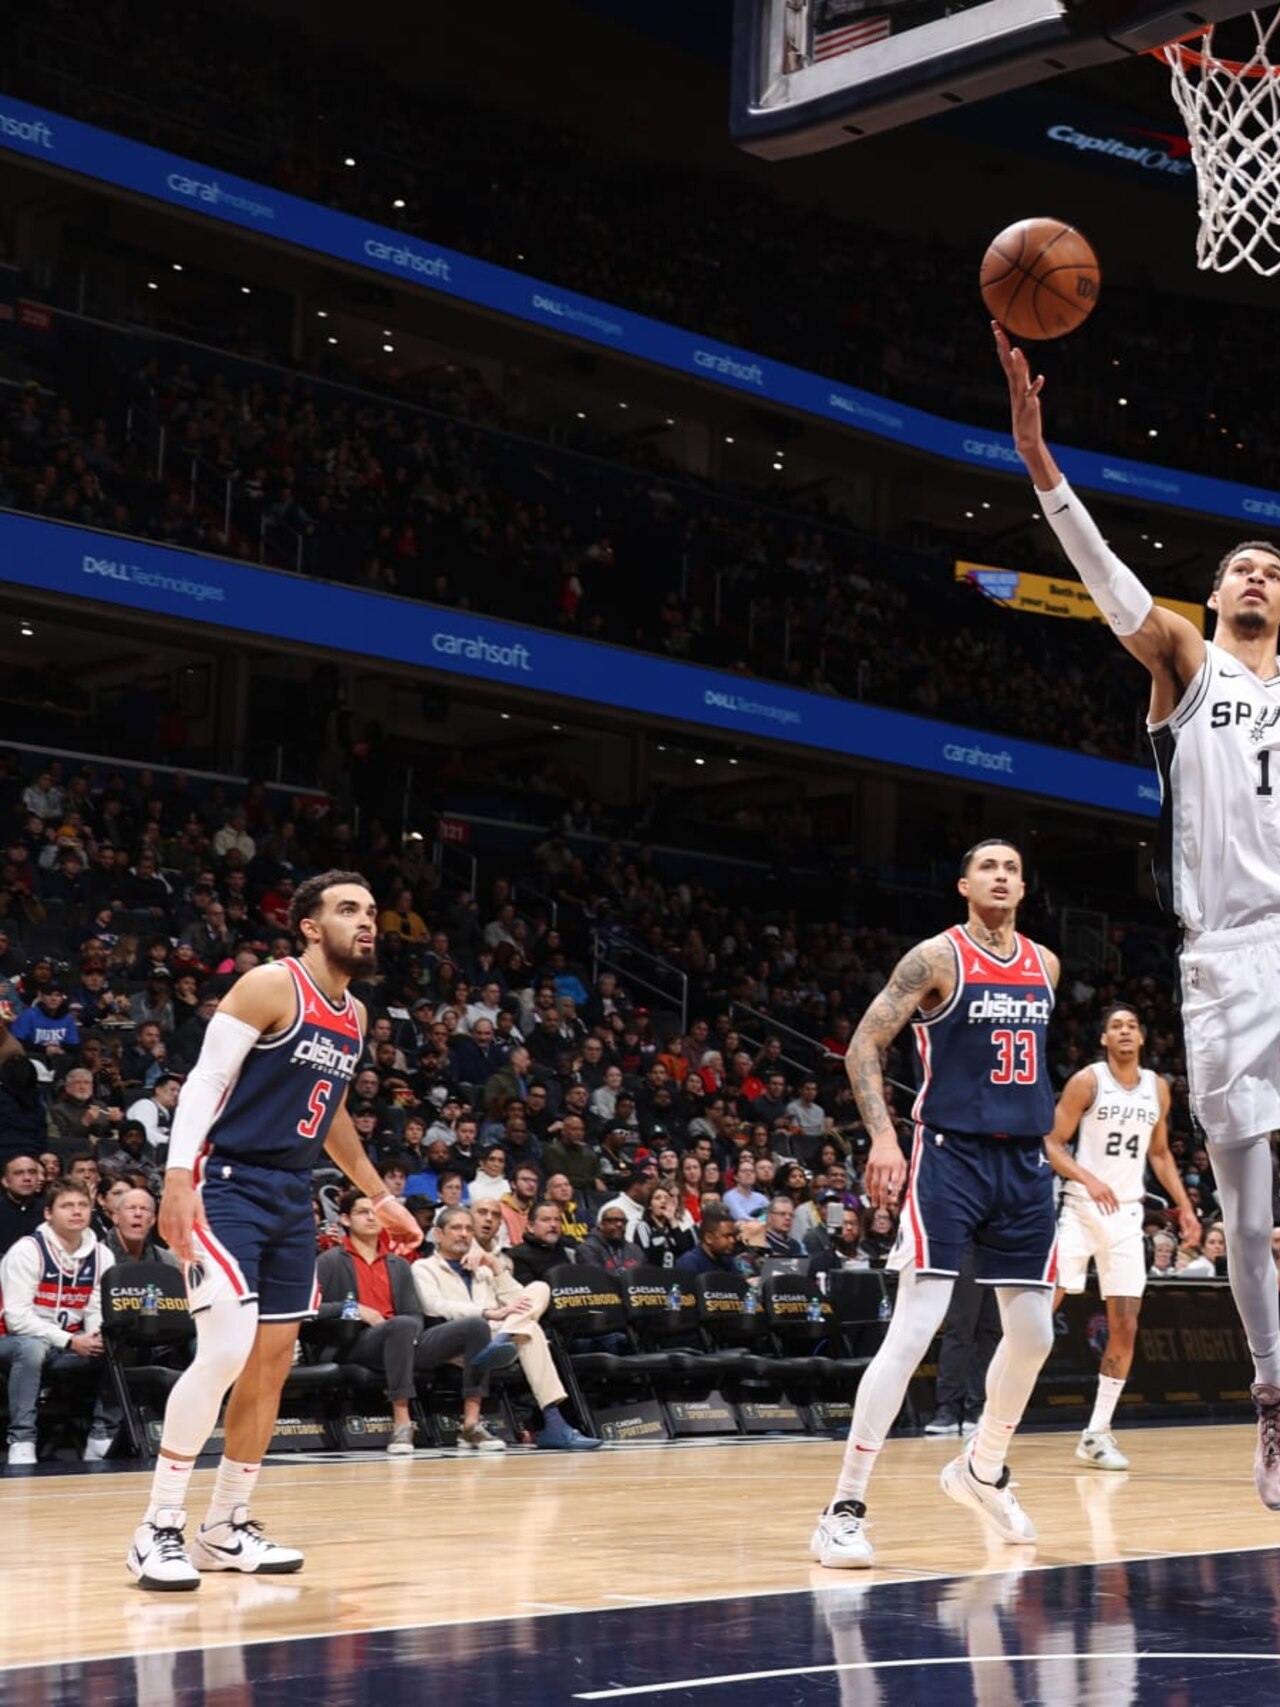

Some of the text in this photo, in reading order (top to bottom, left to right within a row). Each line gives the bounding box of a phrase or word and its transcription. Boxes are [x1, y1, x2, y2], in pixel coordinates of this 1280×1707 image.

[364, 239, 451, 282] carahsoft
[532, 294, 564, 317] DELL
[693, 349, 763, 387] carahsoft
[82, 555, 226, 602] DELL Technologies
[432, 631, 534, 672] carahsoft
[705, 690, 739, 712] DELL
[943, 742, 1016, 775] carahsoft
[1256, 749, 1273, 796] 1
[968, 990, 1049, 1019] district
[990, 1029, 1038, 1085] 33
[297, 1079, 333, 1138] 5
[1097, 1106, 1157, 1127] SPURS
[1105, 1132, 1139, 1158] 24
[552, 1286, 592, 1297] CAESARS
[554, 1293, 622, 1309] SPORTSBOOK
[628, 1286, 667, 1296] CAESARS
[703, 1291, 739, 1300] CAESARS
[771, 1294, 808, 1303] CAESARS
[1140, 1328, 1176, 1364] BET
[1179, 1327, 1238, 1363] RIGHT
